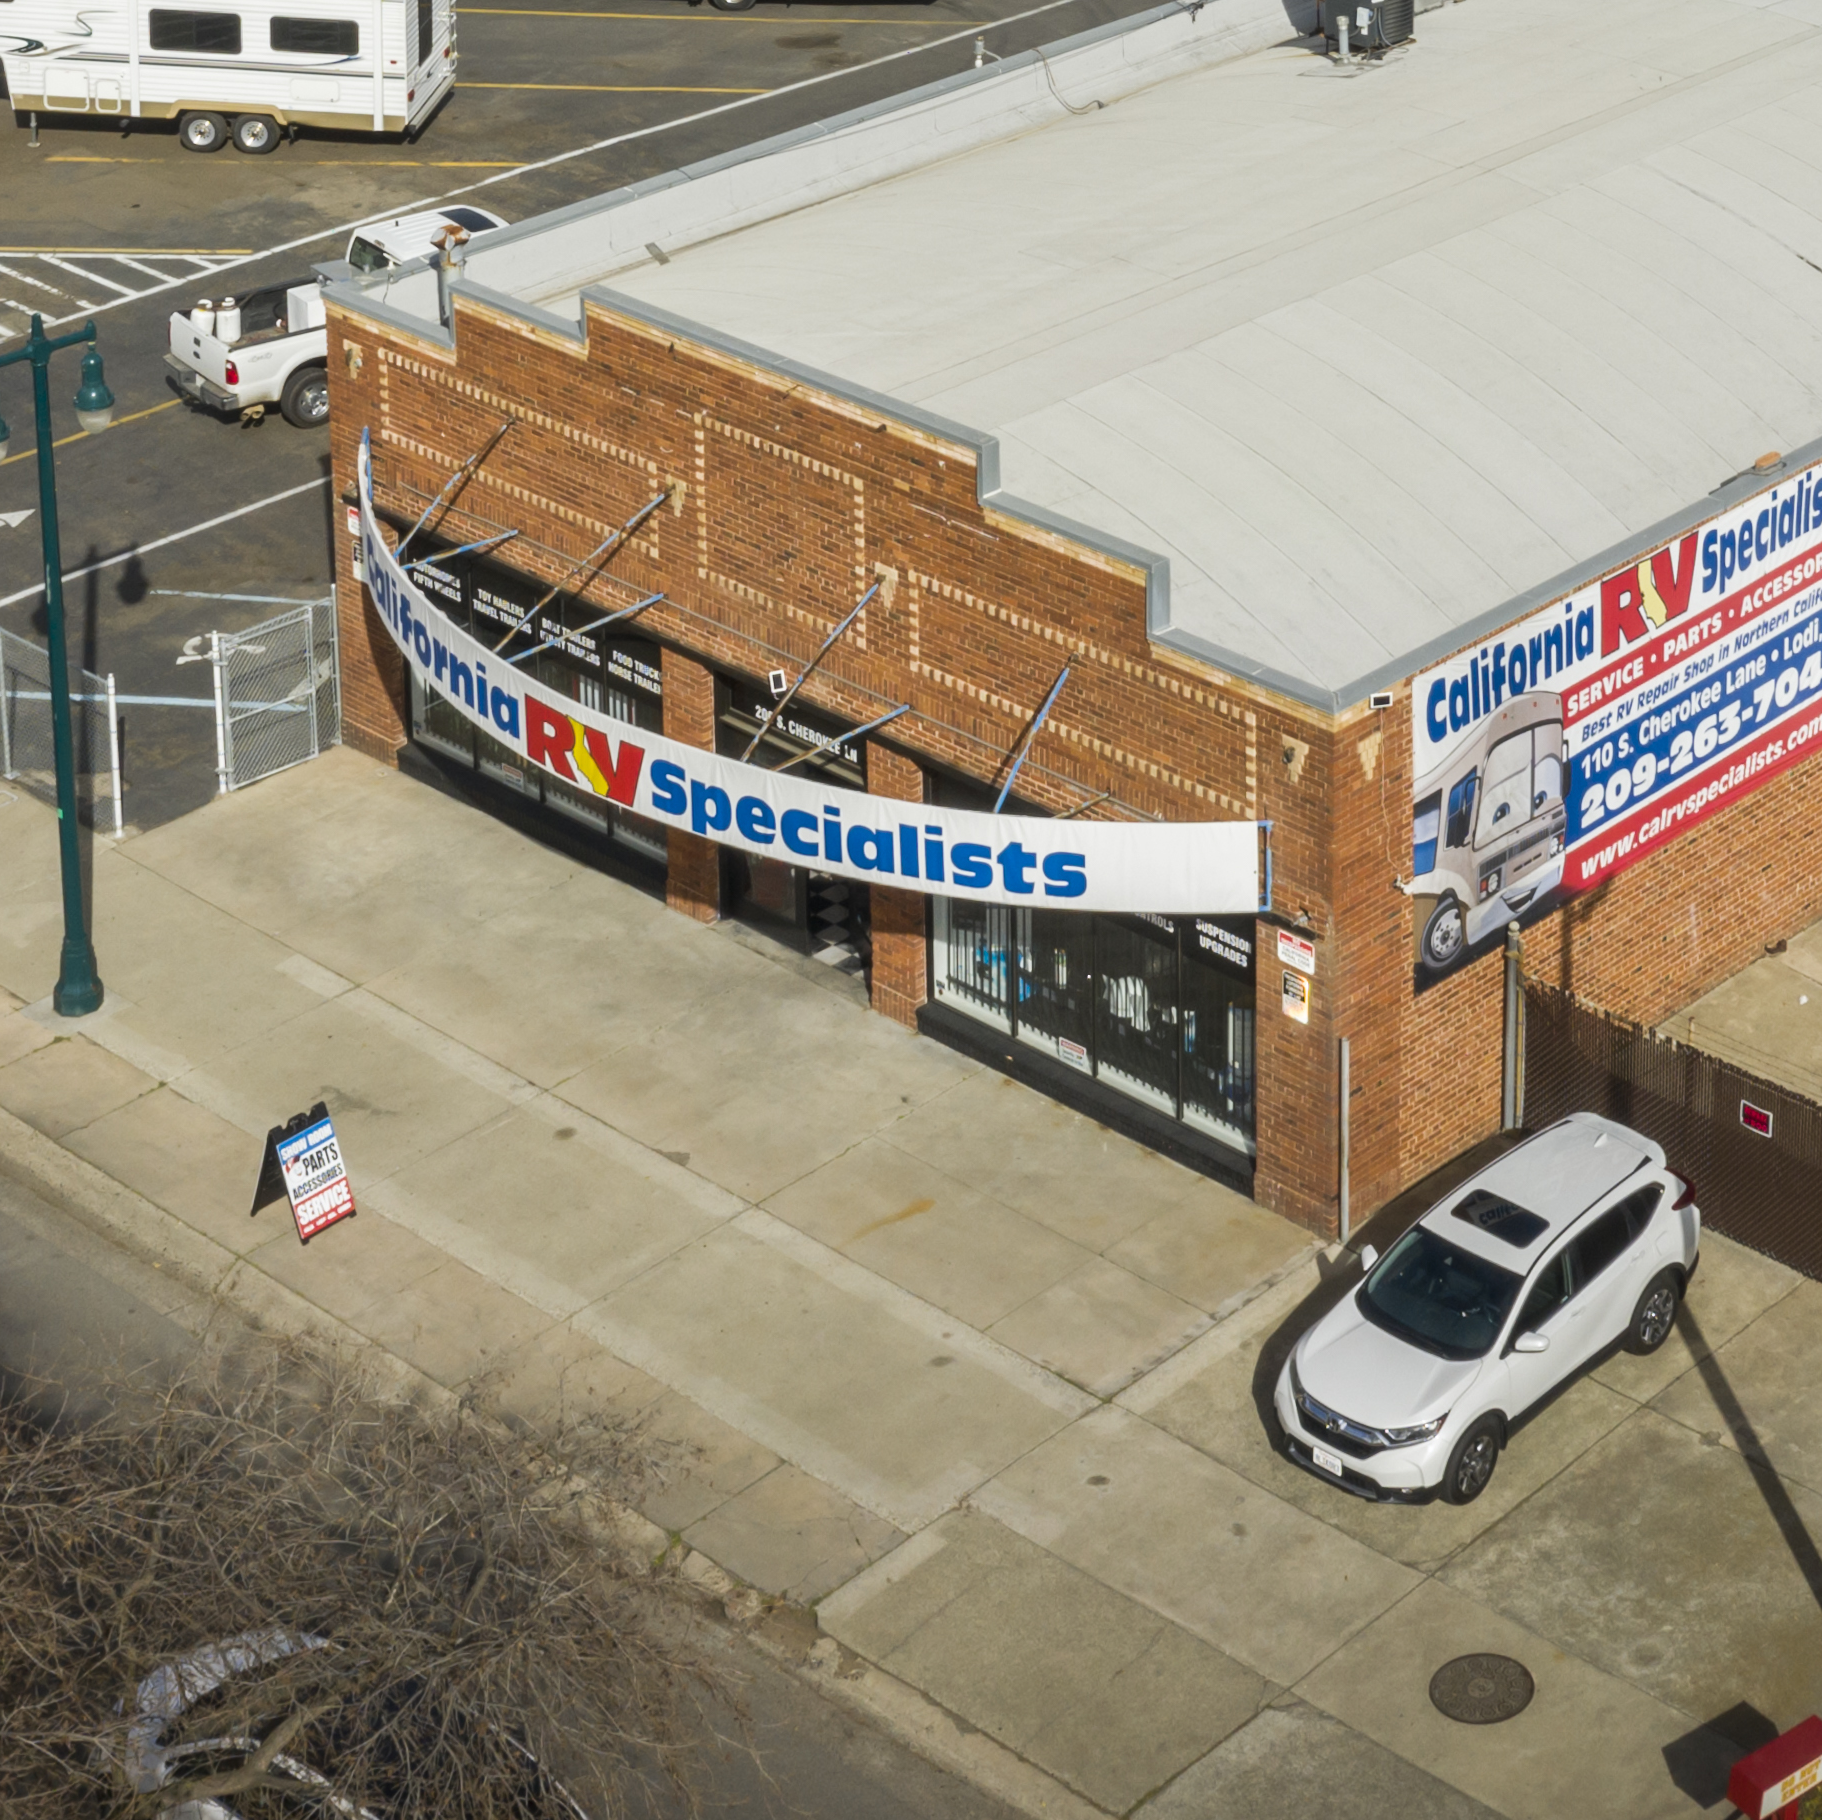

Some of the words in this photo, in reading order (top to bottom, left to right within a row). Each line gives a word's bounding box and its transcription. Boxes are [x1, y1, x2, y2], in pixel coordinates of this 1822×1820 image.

[473, 599, 499, 620] TRAVEL
[477, 588, 492, 604] TOY
[493, 595, 525, 618] HAULERS
[541, 616, 561, 634] BOAT
[1426, 600, 1595, 744] California
[1600, 530, 1699, 659] RV
[608, 661, 632, 682] HORSE
[612, 650, 633, 669] FOOD
[634, 660, 661, 681] TRUCK
[1567, 658, 1644, 718] SERVICE
[1663, 613, 1722, 662] PARTS
[1581, 715, 1612, 744] Best
[1616, 700, 1634, 723] RV
[1637, 673, 1680, 711] Repair
[1683, 652, 1715, 684] Shop
[1718, 641, 1730, 661] in
[1734, 607, 1790, 653] Northern
[366, 533, 520, 740] California
[524, 692, 646, 808] RV
[650, 759, 1088, 898] Specialists
[1581, 744, 1614, 779] 110
[1618, 731, 1634, 759] S.
[1639, 680, 1721, 745] Cherokee
[1725, 655, 1766, 694] Lane
[844, 744, 858, 763] LN
[1199, 934, 1248, 968] UPGRADES
[280, 1136, 308, 1161] SHOW
[302, 1142, 339, 1176] PARTS
[293, 1163, 344, 1200] ACCESSORIES
[296, 1179, 352, 1226] SERVICE
